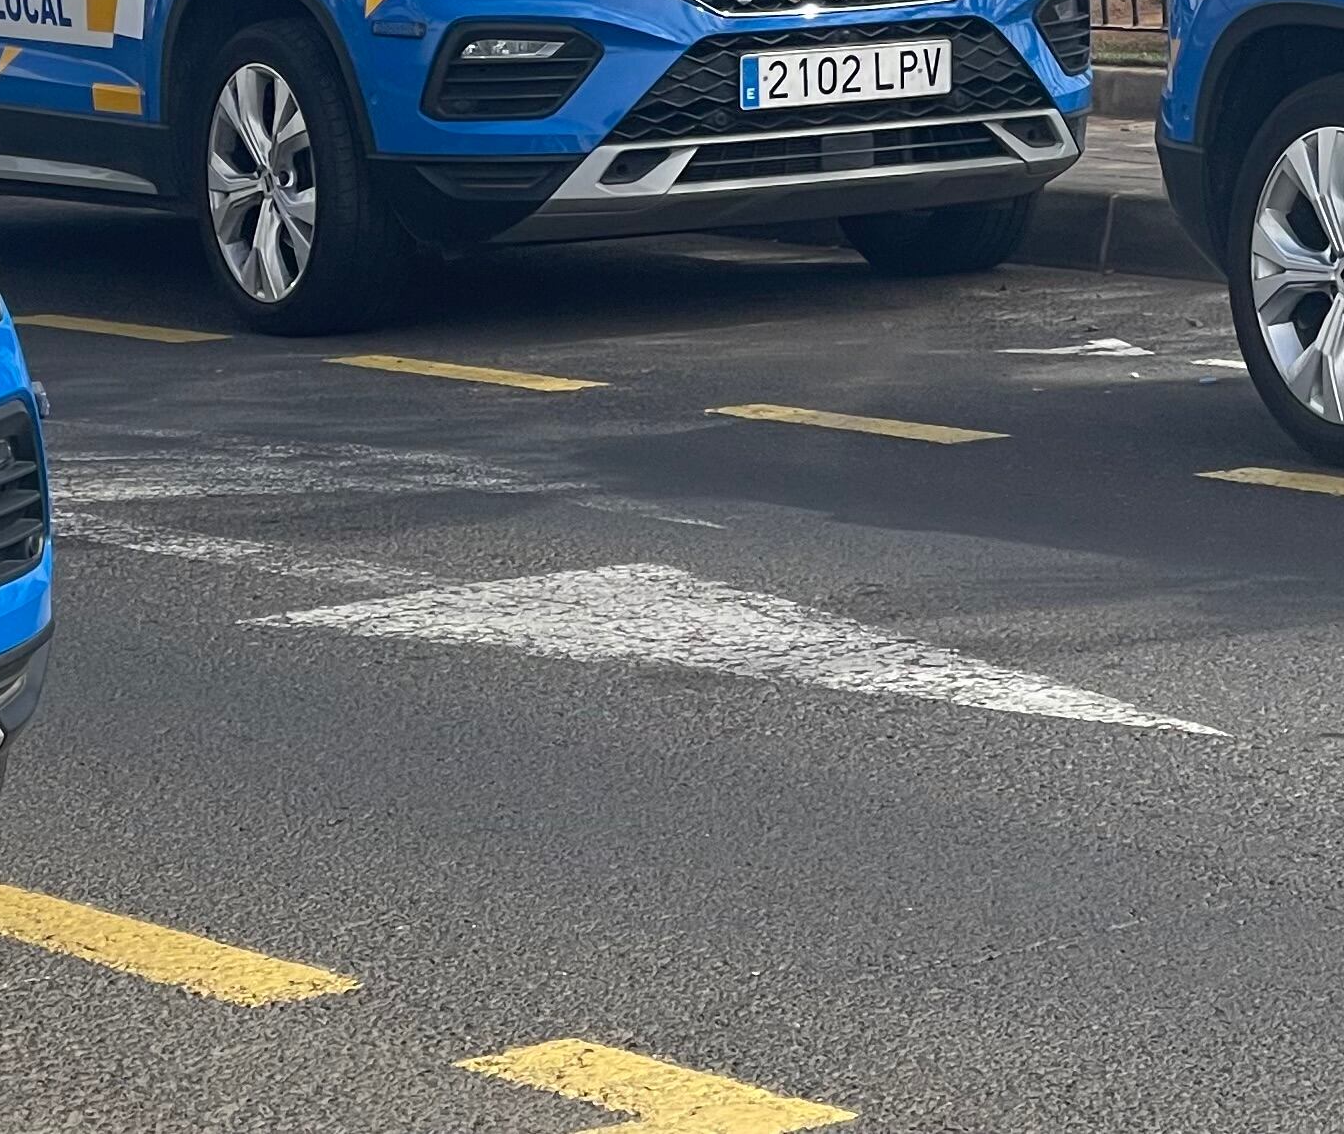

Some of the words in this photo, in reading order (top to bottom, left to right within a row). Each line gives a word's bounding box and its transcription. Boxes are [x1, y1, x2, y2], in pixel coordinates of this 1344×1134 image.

[768, 54, 861, 99] 2102
[874, 47, 941, 90] LPV
[746, 88, 755, 99] E
